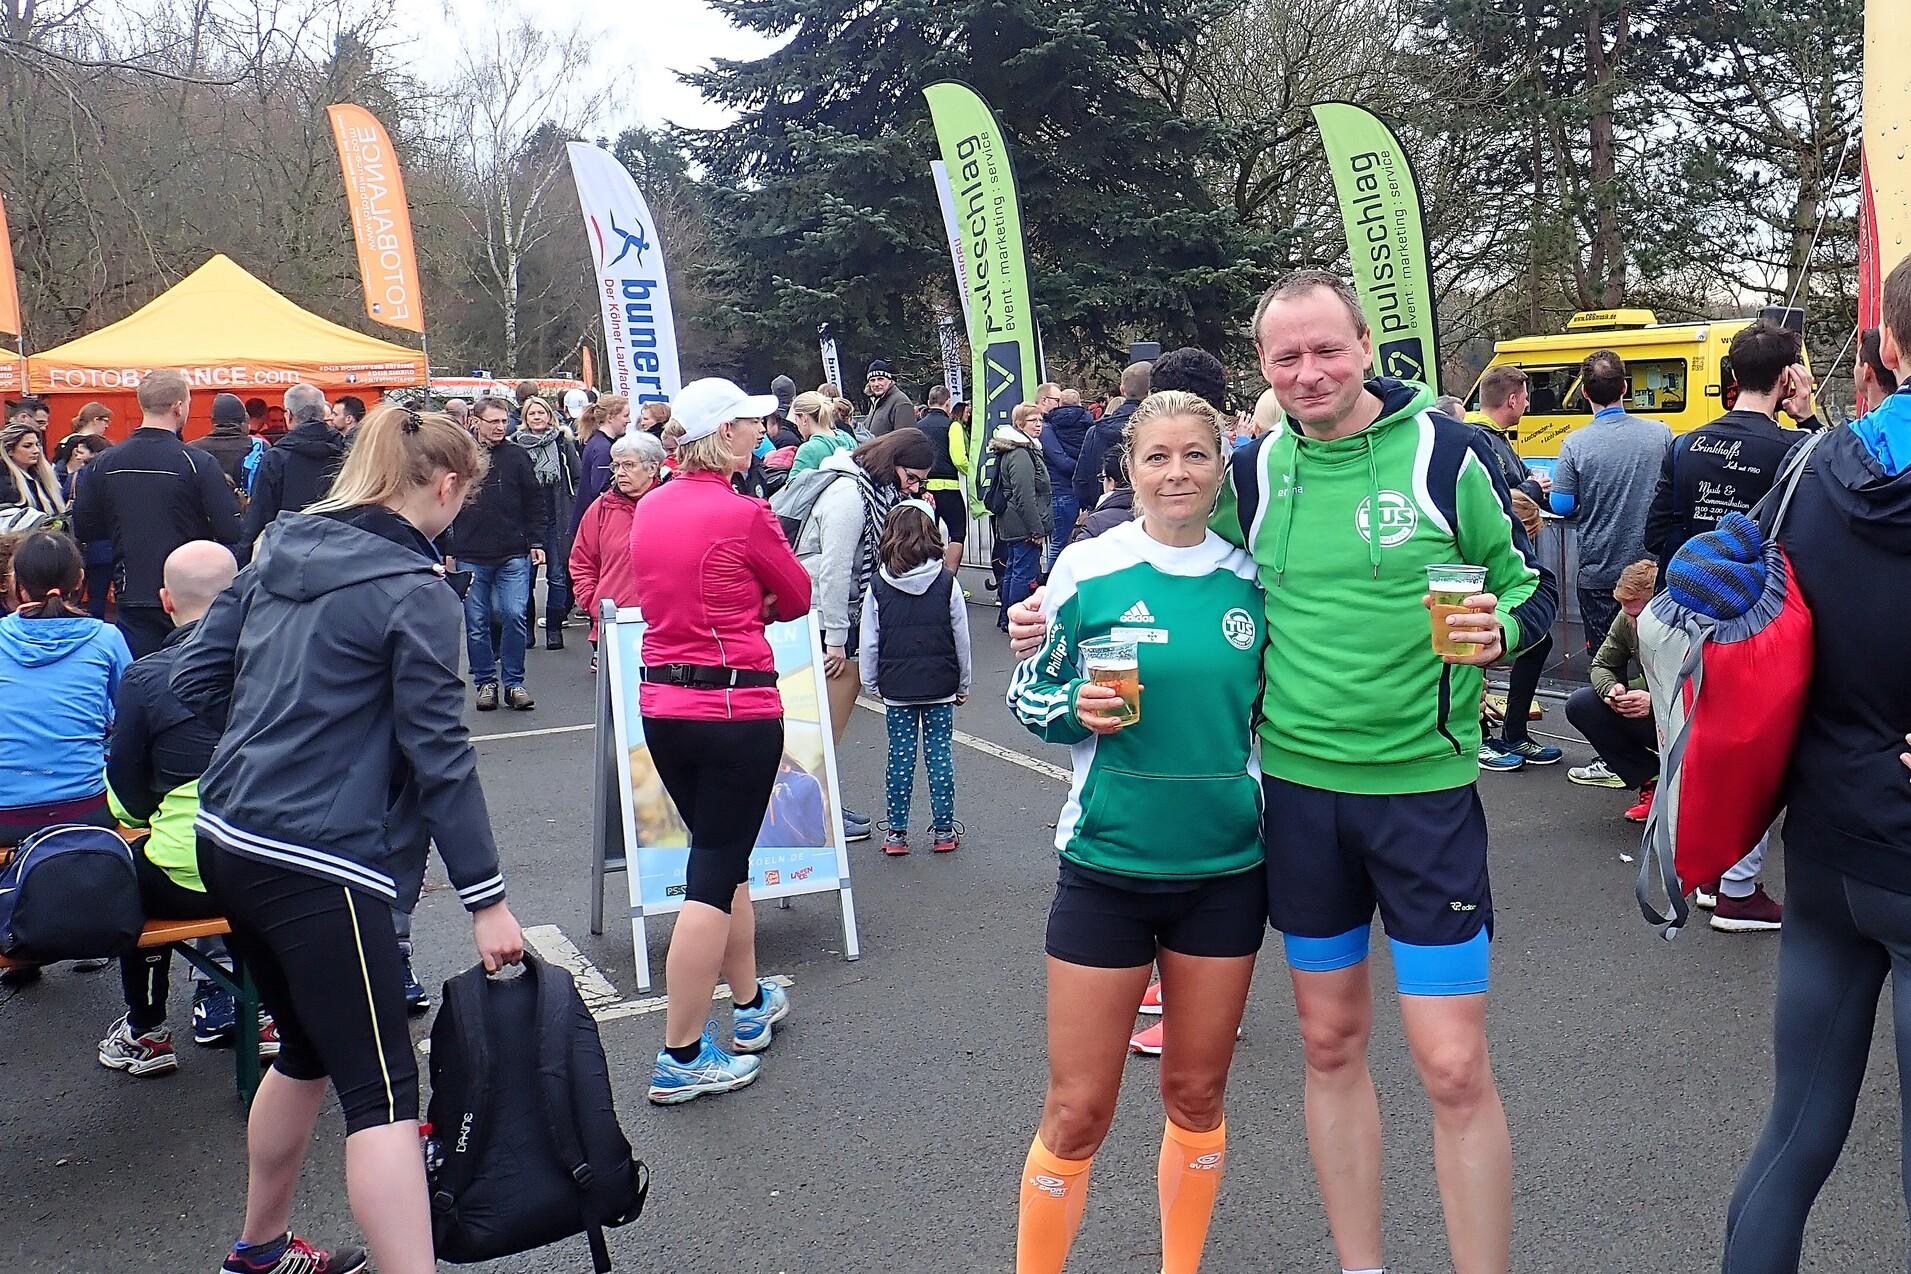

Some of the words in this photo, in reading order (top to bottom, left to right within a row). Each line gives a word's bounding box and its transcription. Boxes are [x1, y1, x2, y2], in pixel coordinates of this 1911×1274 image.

[980, 131, 999, 184] service
[1381, 150, 1402, 198] service
[993, 195, 1011, 276] marketing
[1350, 151, 1410, 333] pulsschlag
[1394, 208, 1411, 279] marketing
[604, 279, 615, 300] Der
[1409, 289, 1418, 329] event
[608, 303, 622, 342] Kölner
[1000, 292, 1016, 332] event
[621, 279, 670, 404] bunert
[50, 366, 299, 388] FOTOBANCE.com
[616, 346, 629, 399] Lauflade
[1120, 615, 1154, 623] adidas
[1226, 620, 1254, 636] TUS
